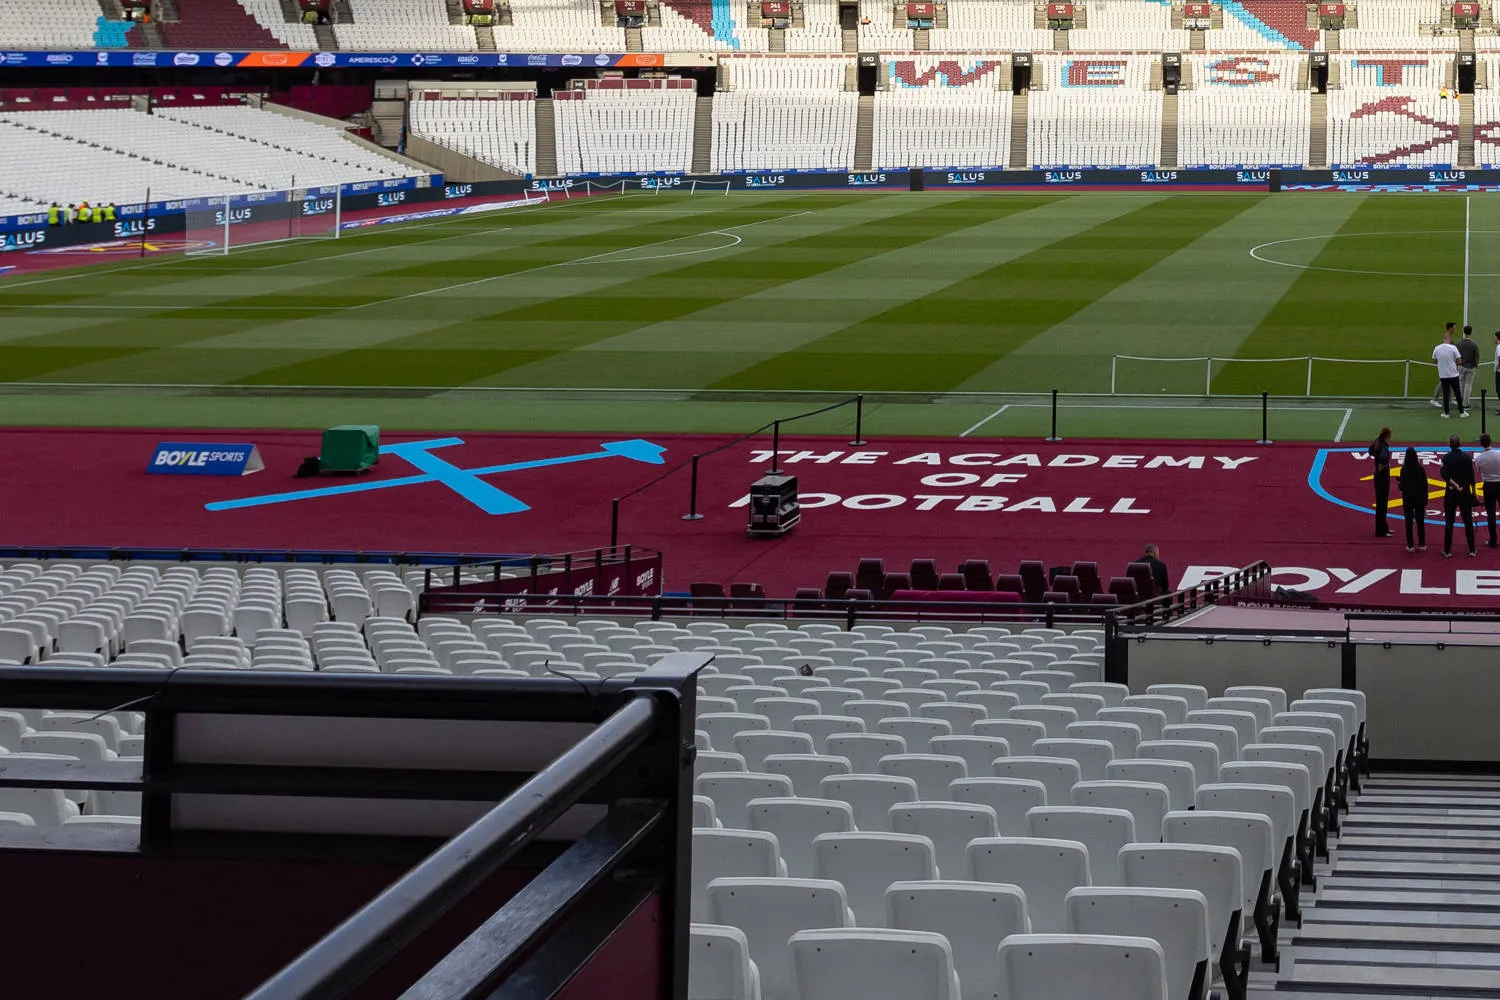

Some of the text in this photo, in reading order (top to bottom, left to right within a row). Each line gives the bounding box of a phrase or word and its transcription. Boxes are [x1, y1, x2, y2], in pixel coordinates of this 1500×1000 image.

[746, 176, 784, 184] SALUS
[848, 174, 886, 182] SALUS
[948, 173, 985, 181] SALUS
[1045, 172, 1081, 180] SALUS
[1141, 171, 1177, 179] SALUS
[1333, 171, 1369, 179] SALUS
[1429, 171, 1465, 179] SALUS
[532, 179, 573, 189] SALUS
[641, 177, 680, 186] SALUS
[445, 185, 471, 196] SALUS
[378, 191, 405, 203] SALUS
[303, 199, 334, 212] SALUS
[0, 231, 46, 247] SALUS
[155, 451, 245, 466] BOYLE SPORTS
[750, 451, 1260, 470] THE ACADEMY
[920, 473, 1029, 488] OF
[637, 568, 655, 586] BOYLE
[575, 579, 593, 597] BOYLE
